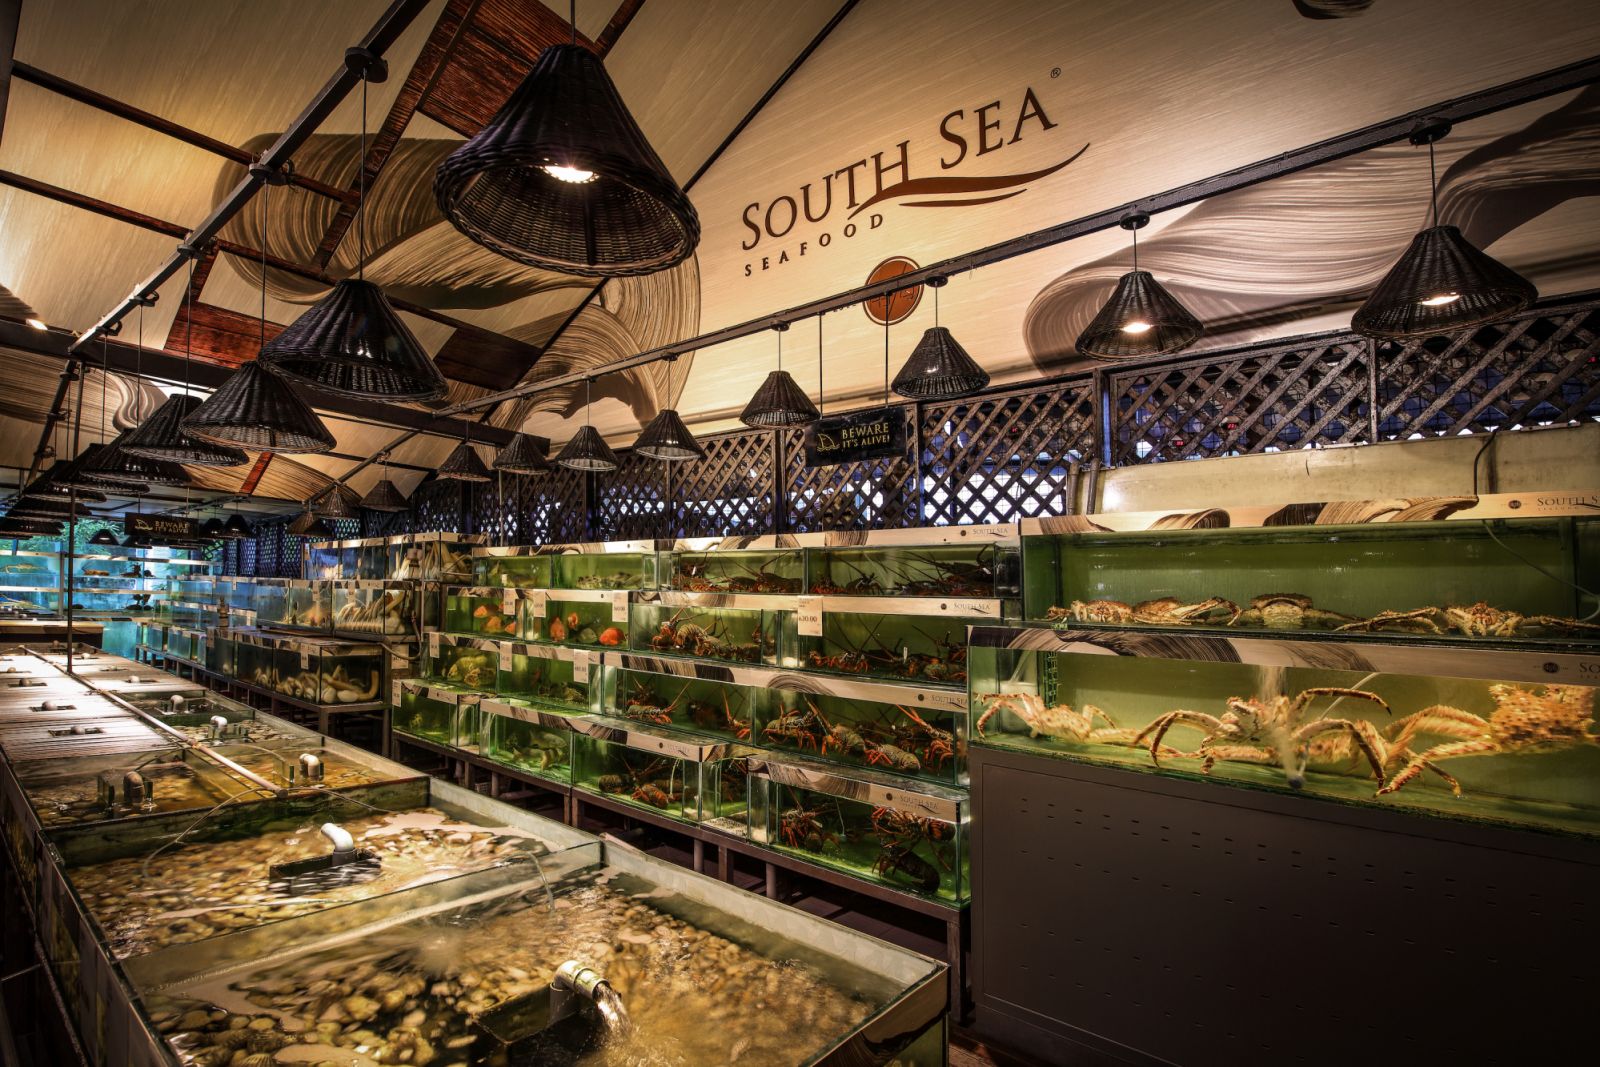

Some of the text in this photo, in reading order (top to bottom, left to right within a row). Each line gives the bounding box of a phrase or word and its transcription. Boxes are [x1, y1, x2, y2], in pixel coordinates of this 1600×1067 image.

[742, 87, 1058, 251] SOUTH SEA
[744, 213, 884, 277] SEAFOOD
[843, 423, 888, 439] BEWARE
[862, 436, 890, 446] ALIVE!
